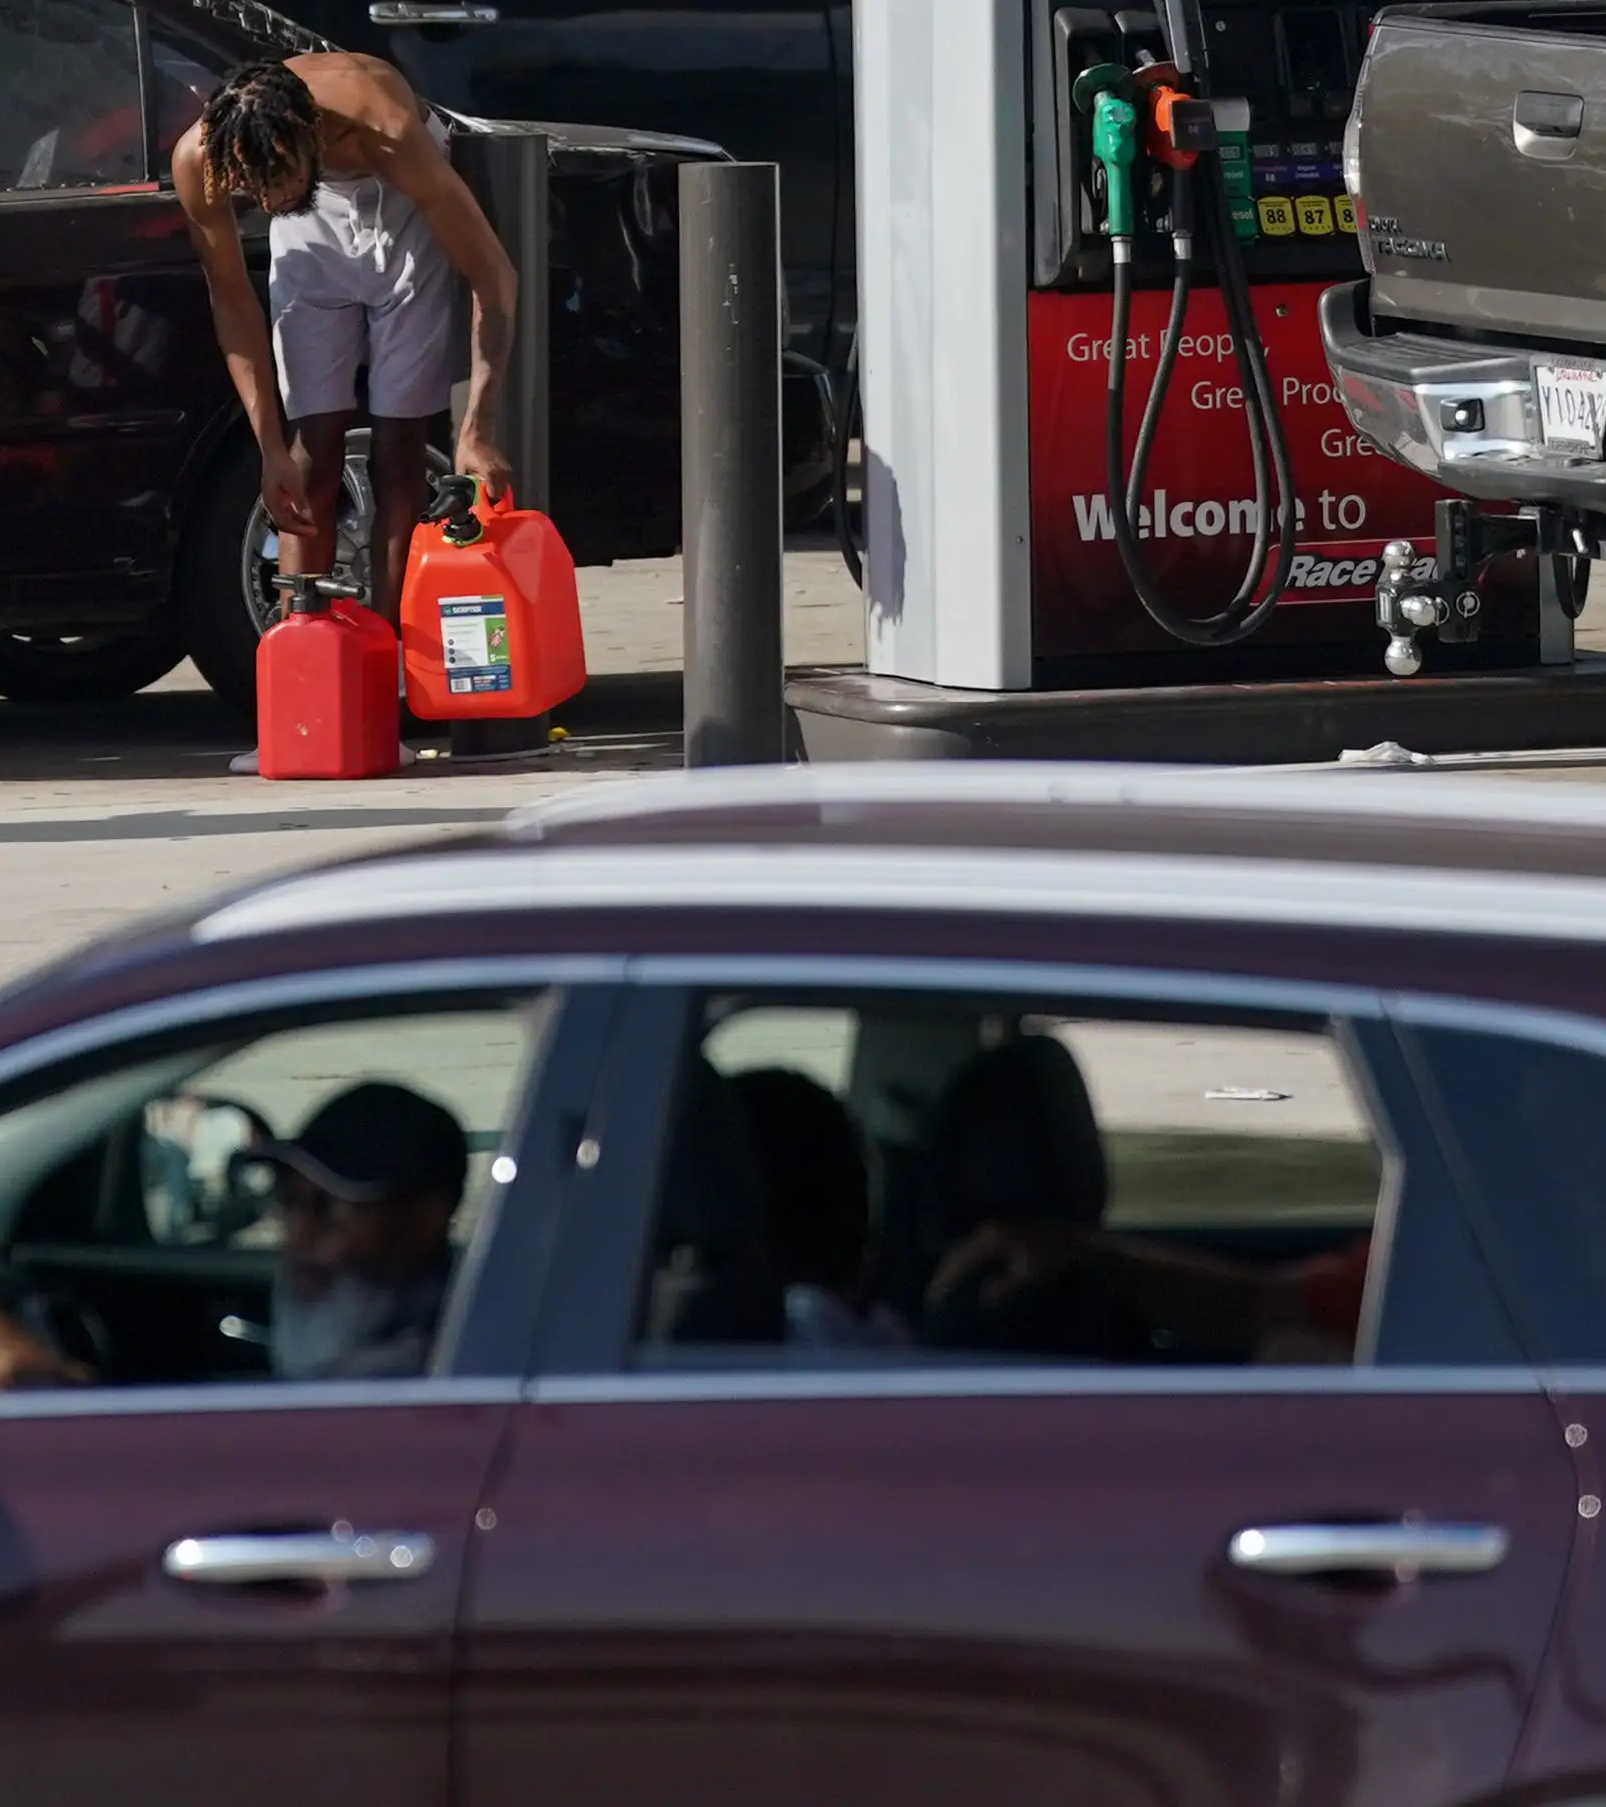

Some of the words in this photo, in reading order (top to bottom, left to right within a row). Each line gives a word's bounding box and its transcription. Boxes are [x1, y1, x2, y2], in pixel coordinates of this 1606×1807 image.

[1265, 208, 1287, 225] 88
[1303, 209, 1325, 225] 87
[1066, 332, 1151, 362] Great
[1318, 488, 1366, 531] to
